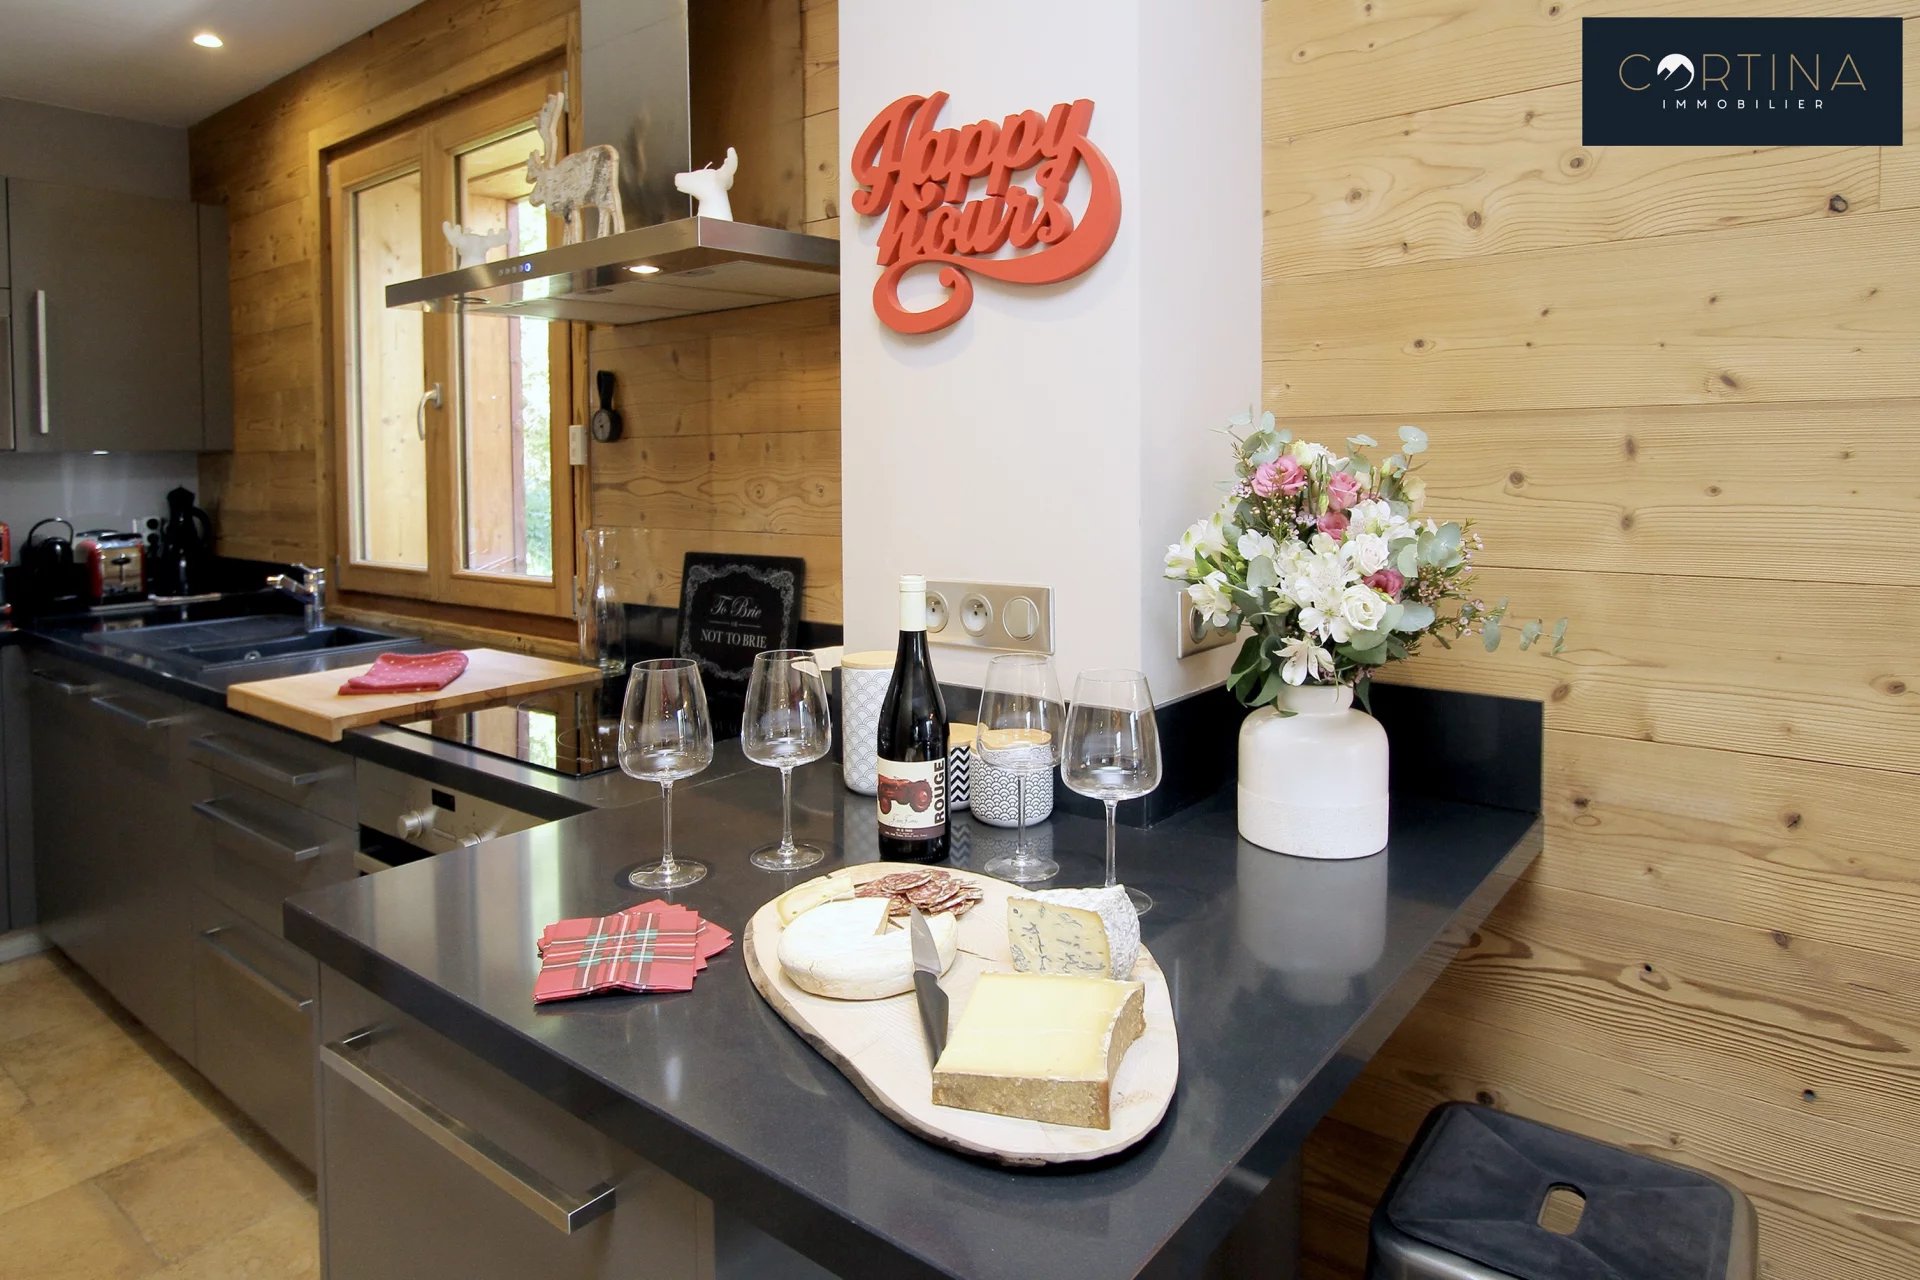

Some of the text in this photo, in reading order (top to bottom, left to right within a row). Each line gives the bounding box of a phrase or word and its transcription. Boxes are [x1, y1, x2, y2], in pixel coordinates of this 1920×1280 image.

[851, 91, 1095, 216] Happy
[710, 595, 762, 619] To Brie
[701, 629, 767, 648] NOT TO BRIE
[933, 761, 945, 824] ROUGE
